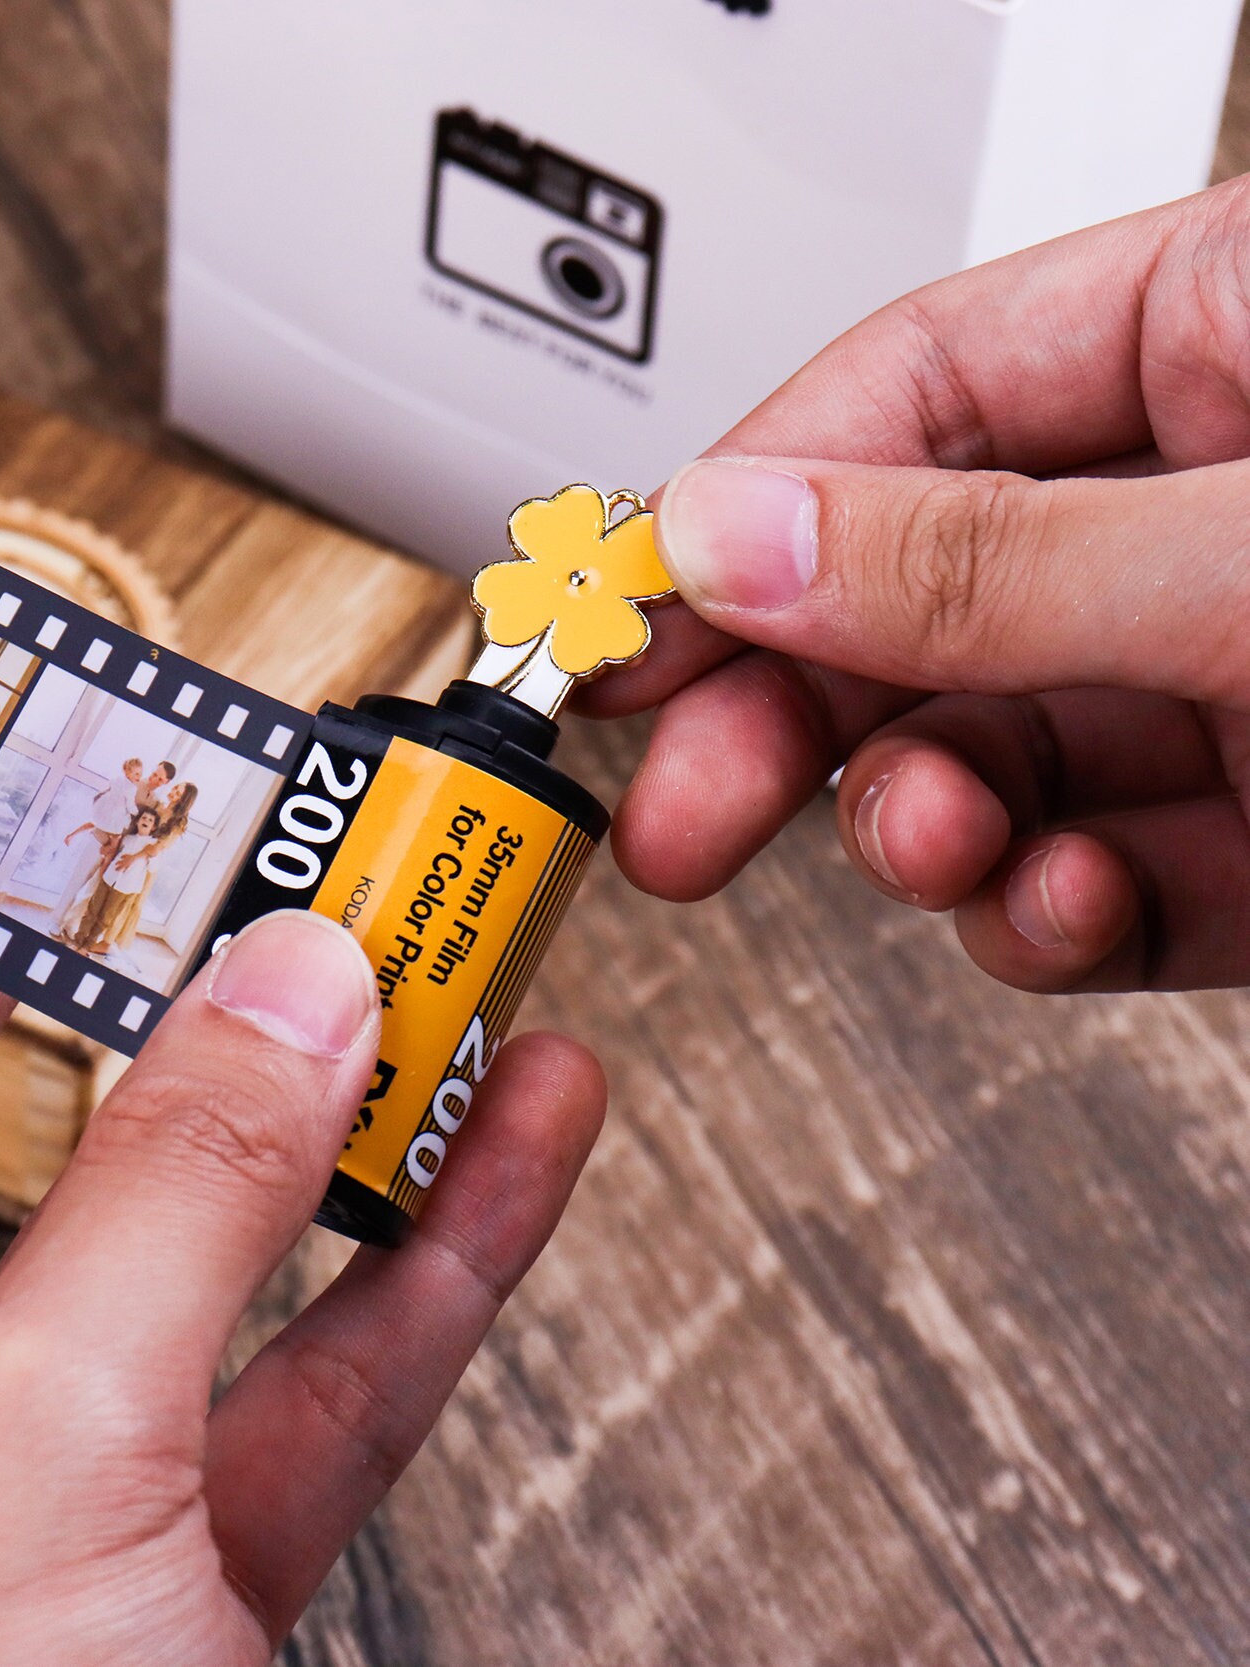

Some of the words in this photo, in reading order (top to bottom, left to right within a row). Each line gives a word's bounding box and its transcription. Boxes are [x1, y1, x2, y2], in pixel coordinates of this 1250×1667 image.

[256, 741, 367, 889] 200
[446, 804, 487, 851] for
[341, 876, 375, 929] KODA
[404, 852, 462, 936] Color
[460, 826, 523, 918] 35mm
[427, 919, 479, 985] Film
[406, 1013, 500, 1189] 200
